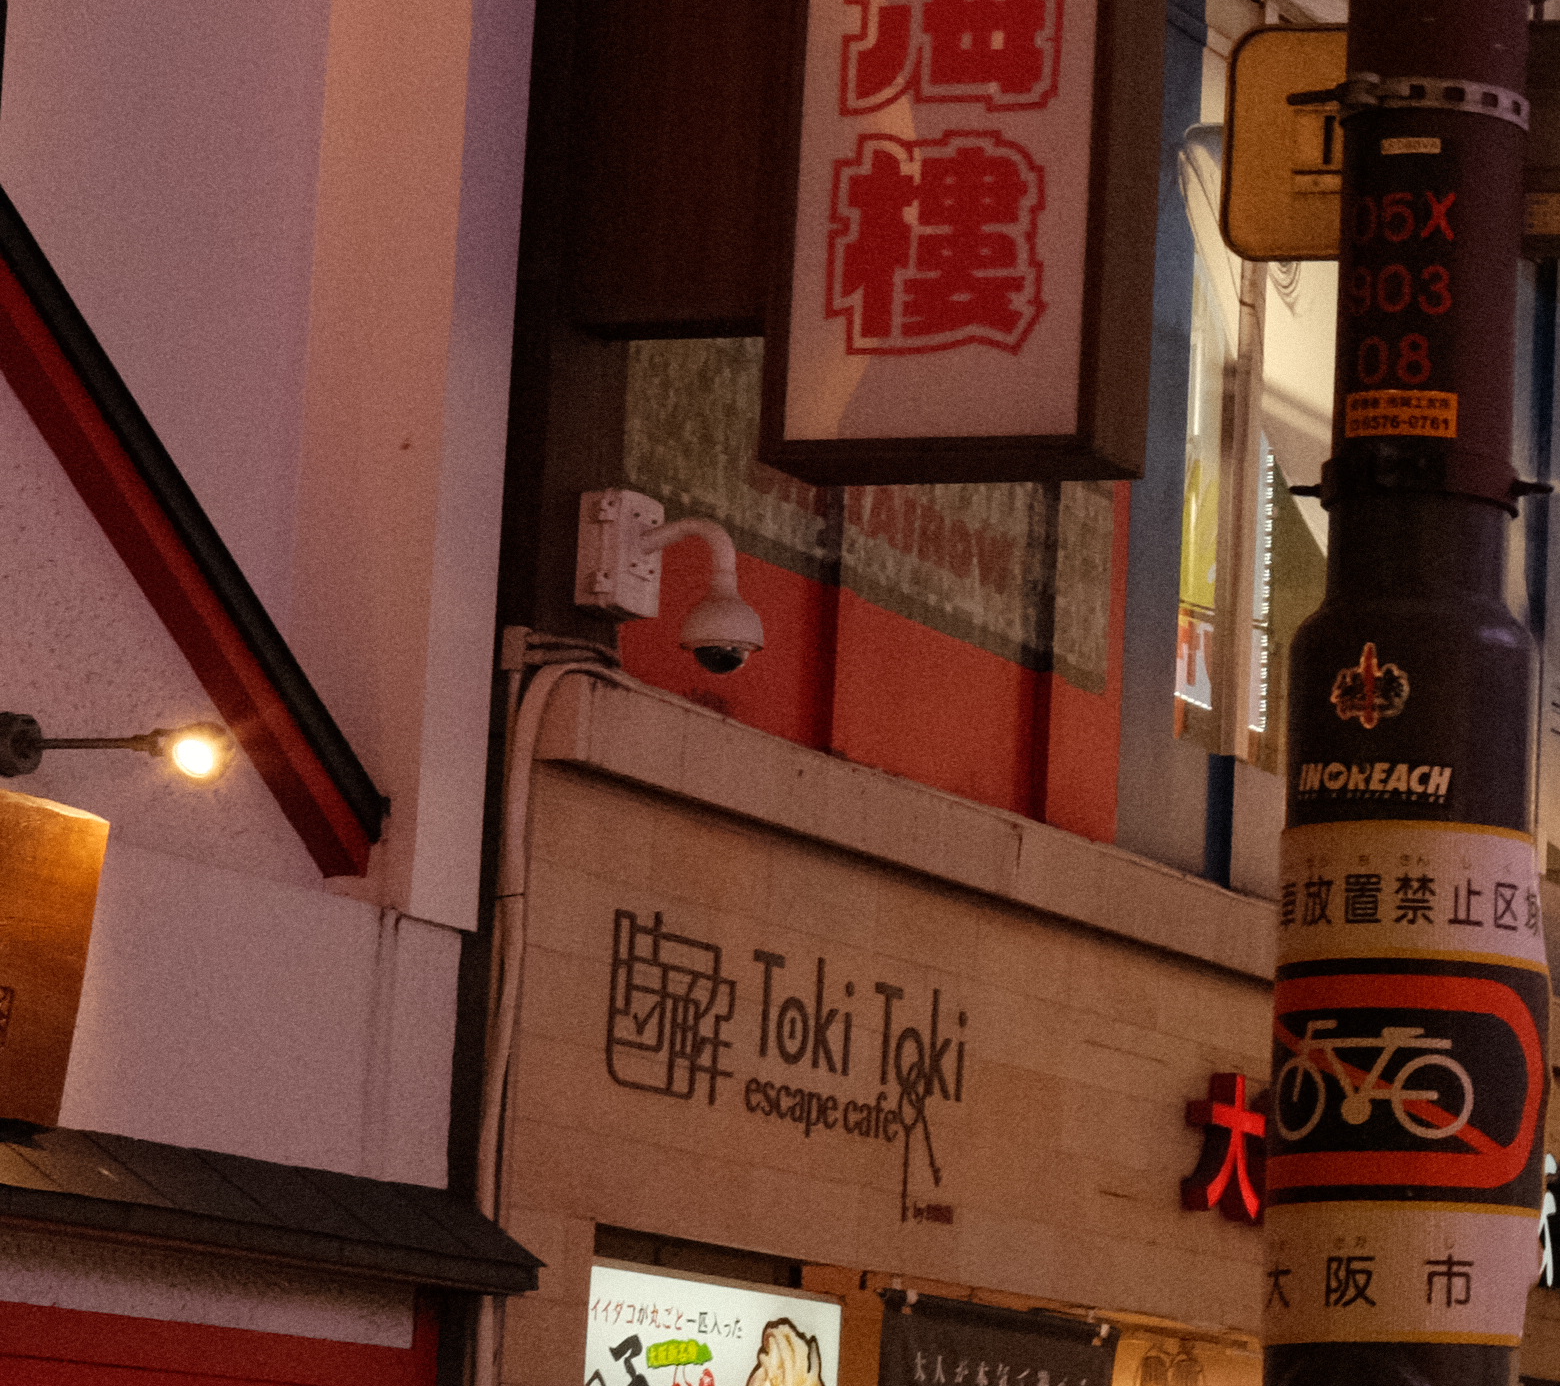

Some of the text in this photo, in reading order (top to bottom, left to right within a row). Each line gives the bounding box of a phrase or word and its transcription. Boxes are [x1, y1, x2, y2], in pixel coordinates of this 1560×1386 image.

[1357, 332, 1432, 385] 08
[753, 949, 969, 1104] Toki Toki
[744, 1070, 899, 1144] escape cafe
[590, 1297, 744, 1340] イイダコが丸ごと一匹入った
